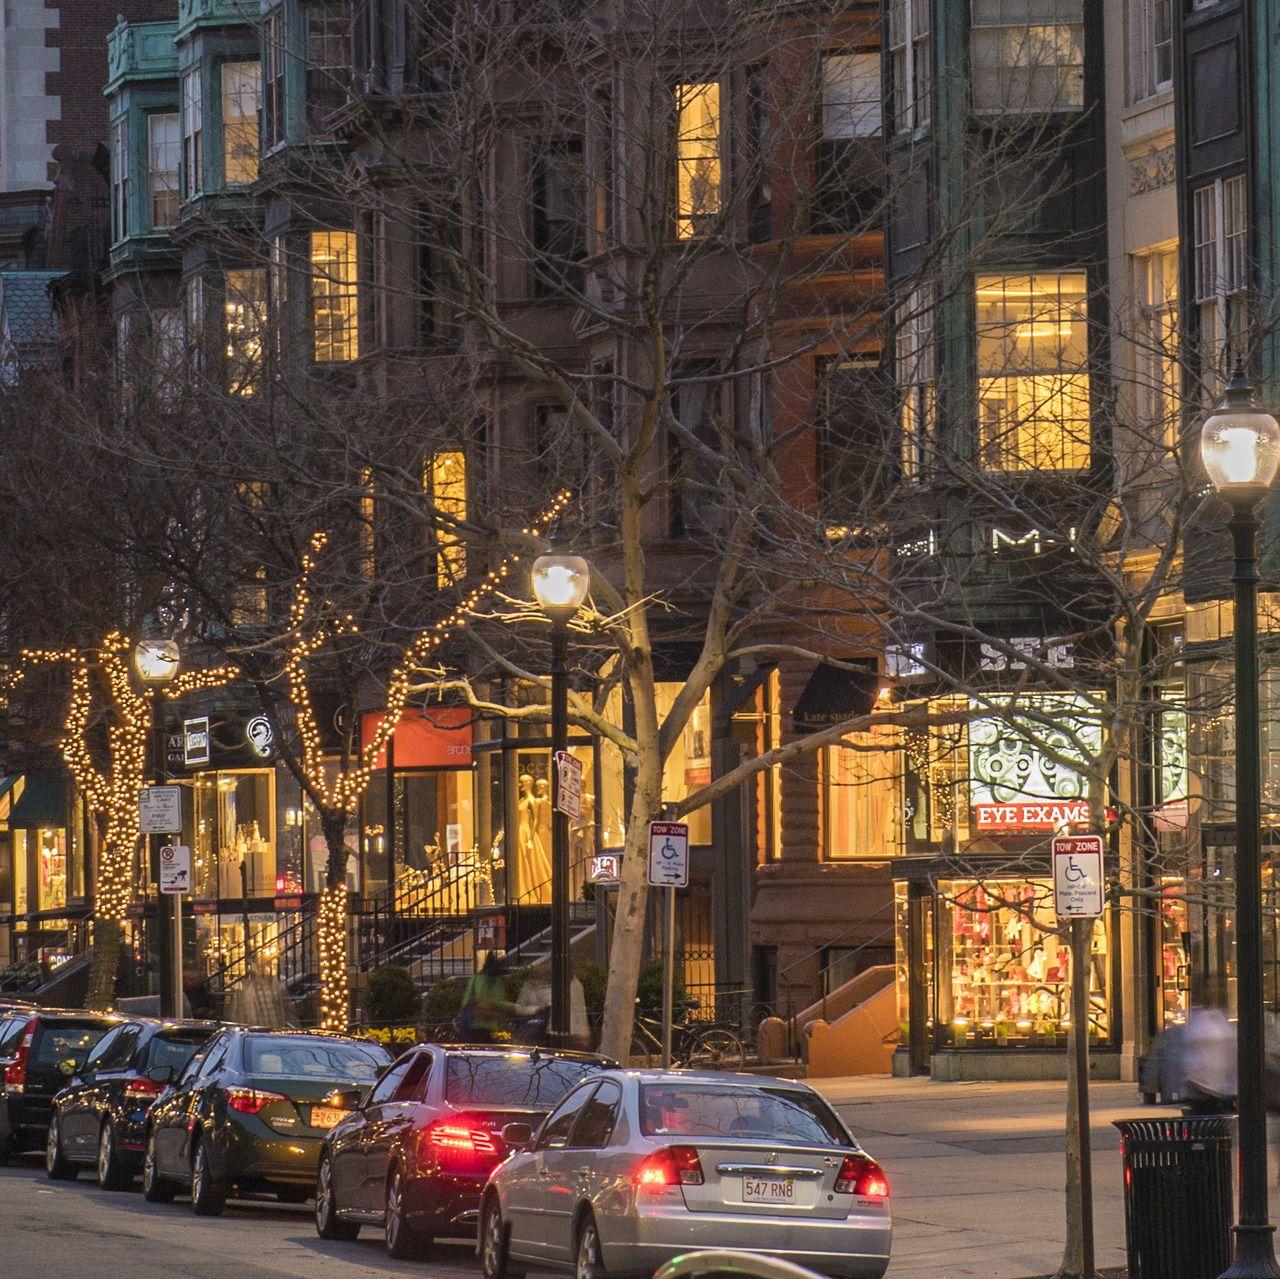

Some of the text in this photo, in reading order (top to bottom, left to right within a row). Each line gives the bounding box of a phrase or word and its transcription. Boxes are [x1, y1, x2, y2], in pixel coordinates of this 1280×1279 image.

[978, 806, 1089, 823] EYE EXAMS
[652, 825, 687, 835] TOW ZONE
[1056, 841, 1098, 852] TOW ZONE
[745, 1181, 794, 1198] 547 RN8
